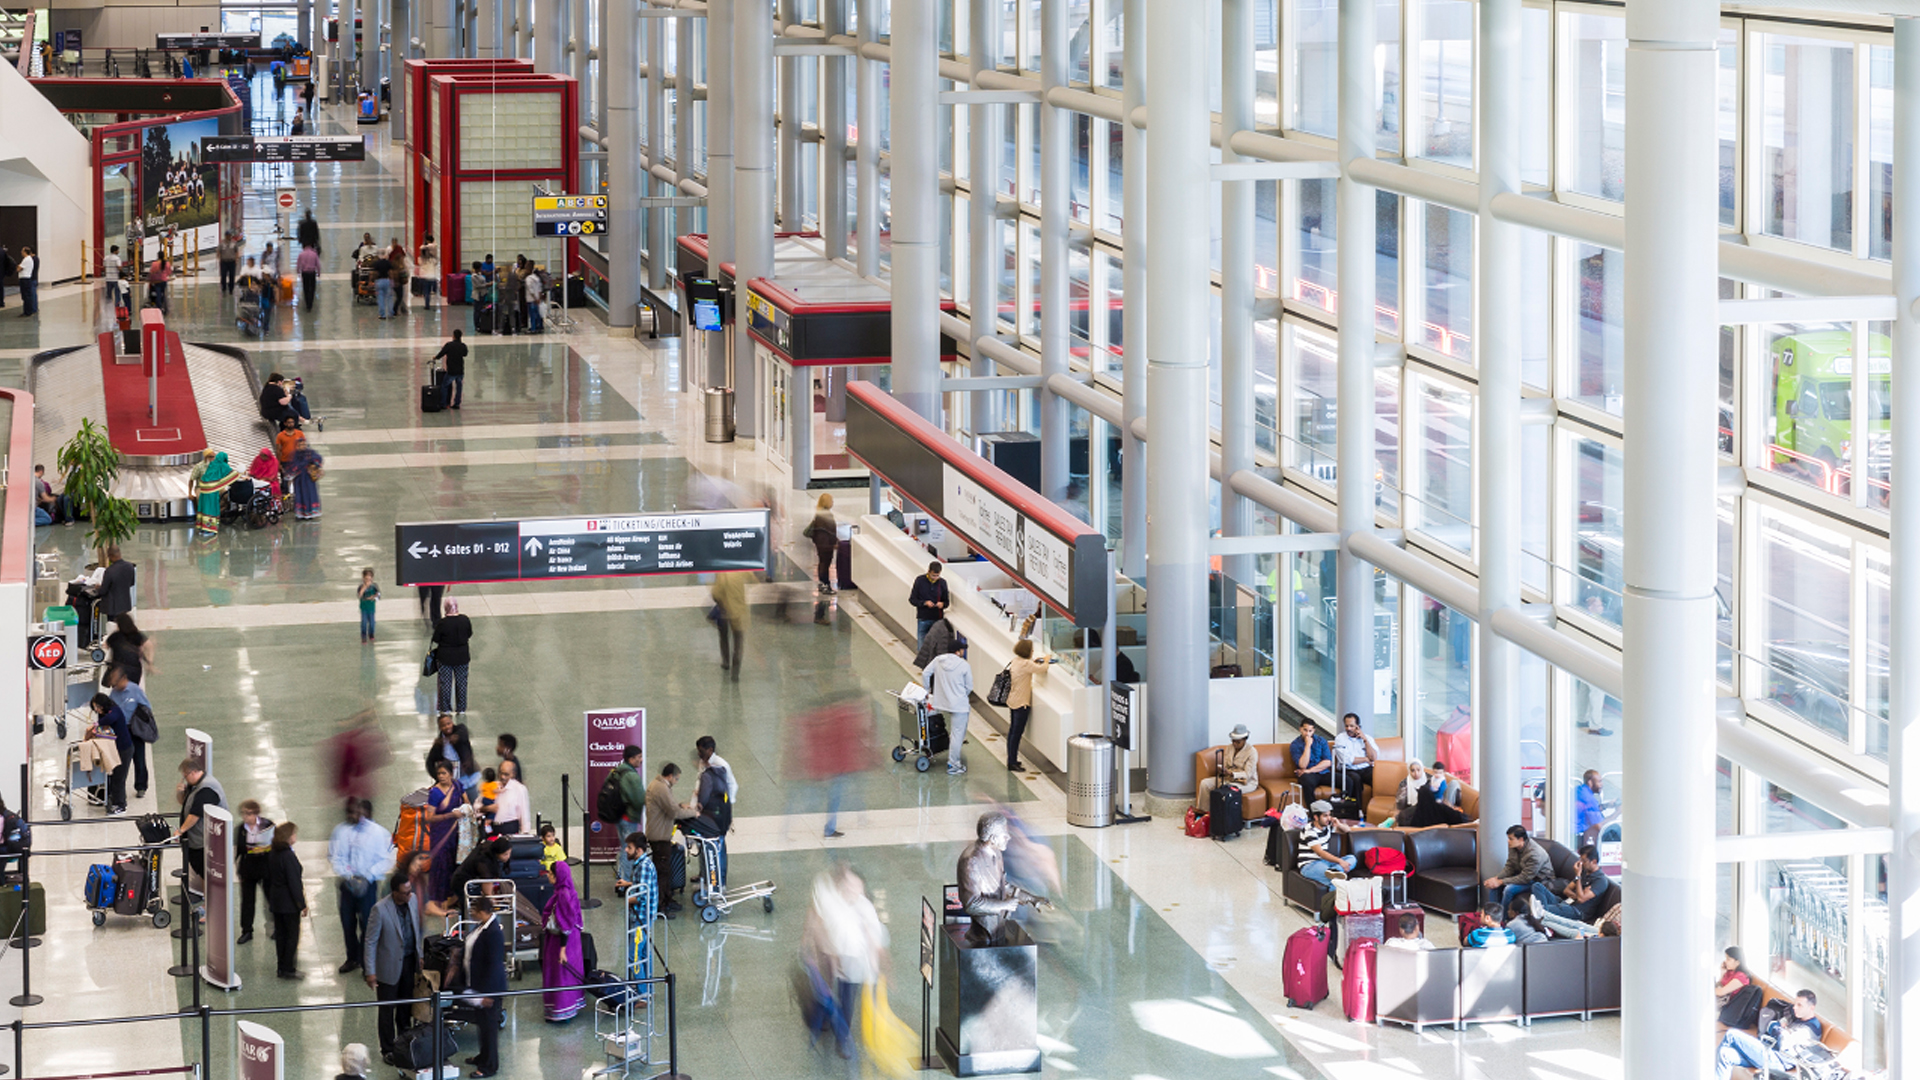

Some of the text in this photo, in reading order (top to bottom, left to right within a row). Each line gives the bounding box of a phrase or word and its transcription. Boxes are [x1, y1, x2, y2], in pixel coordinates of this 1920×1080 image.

[576, 198, 584, 206] C
[558, 223, 566, 234] P
[1783, 352, 1793, 364] 77
[444, 544, 471, 556] Gates
[474, 543, 484, 554] D1
[494, 542, 510, 553] D12
[38, 649, 60, 658] AED
[593, 718, 626, 728] QATAR
[590, 742, 624, 751] Check-in
[590, 760, 620, 768] Economy
